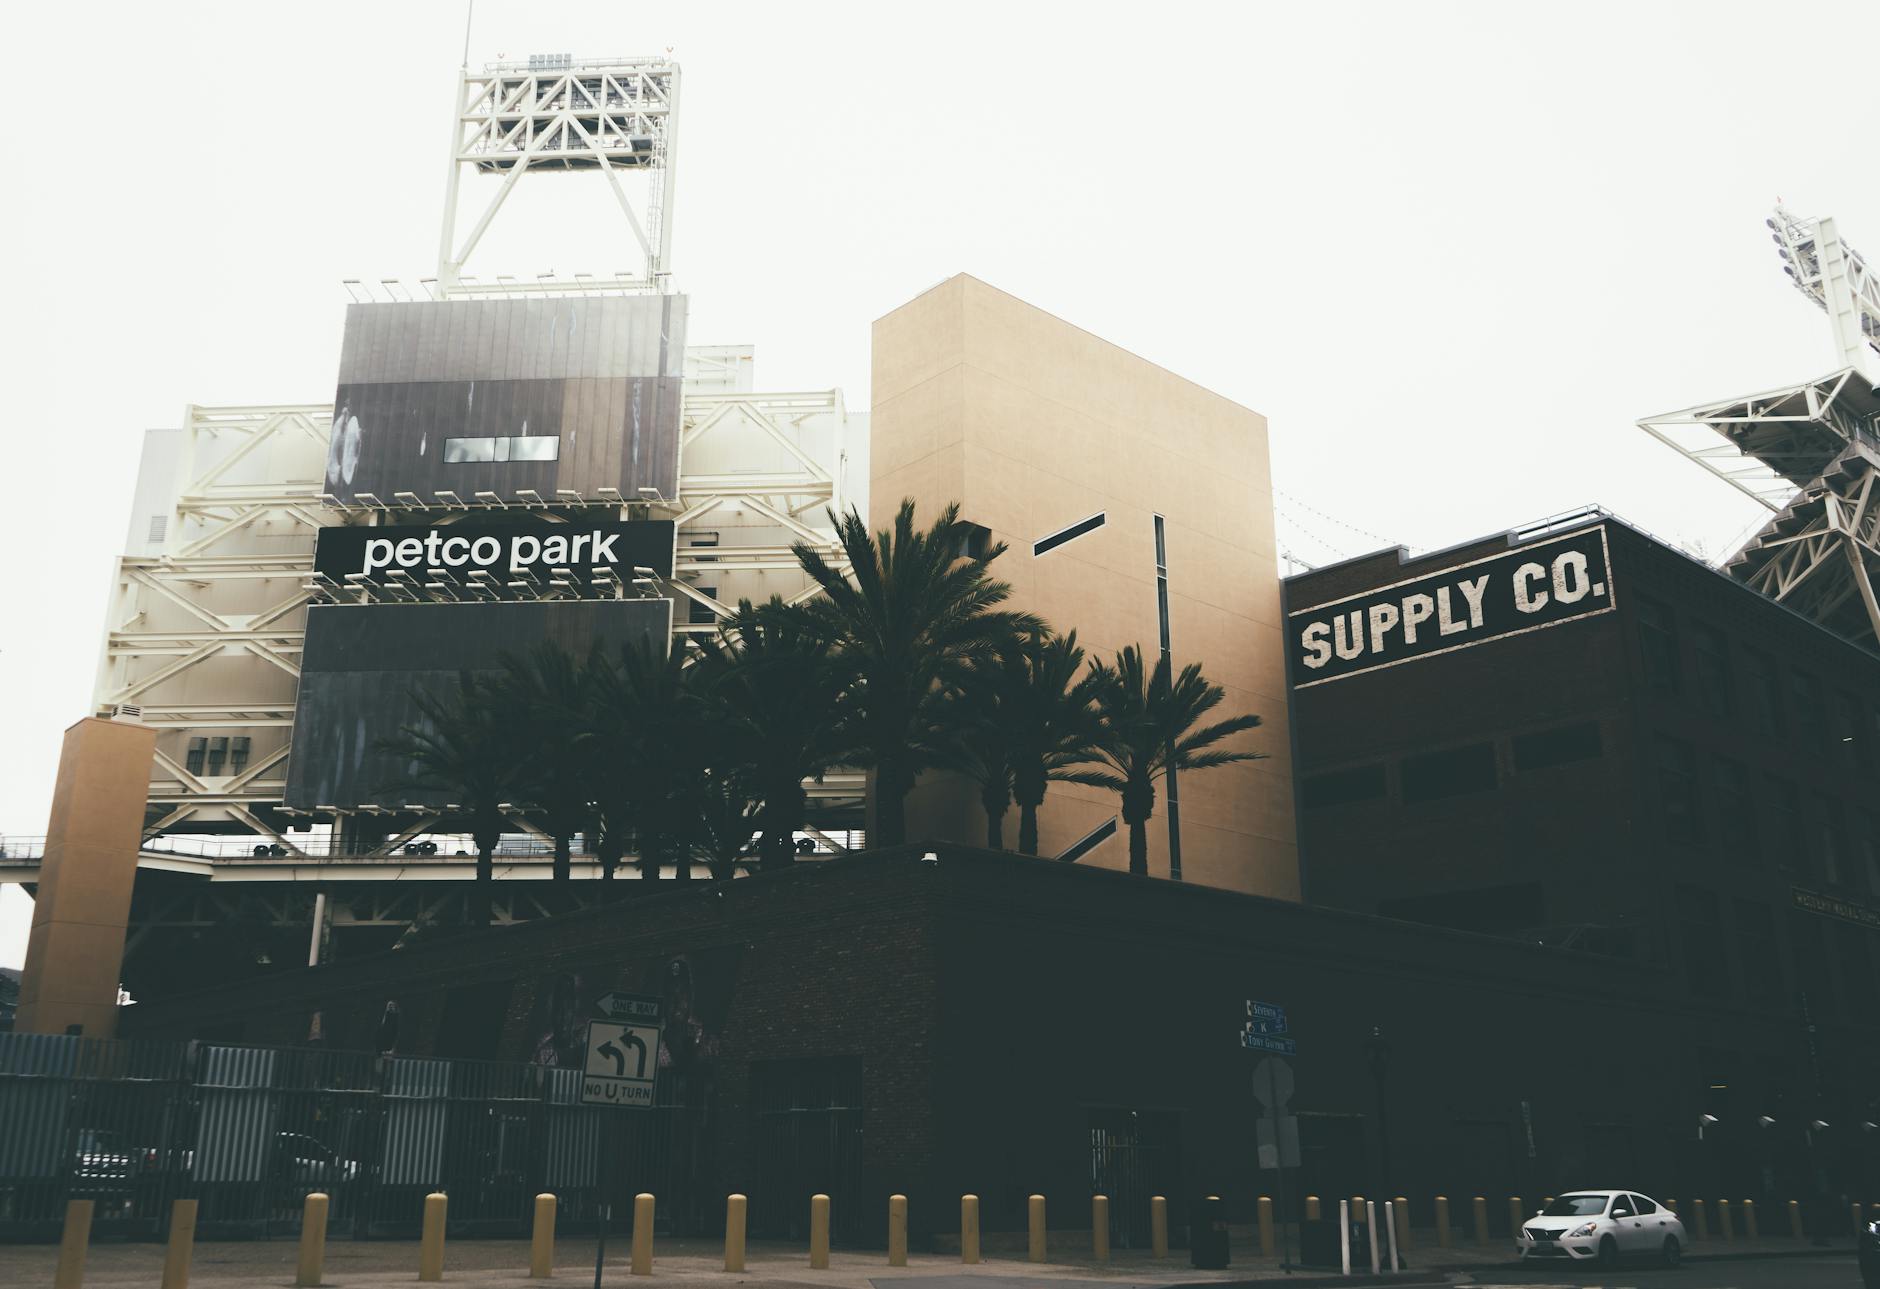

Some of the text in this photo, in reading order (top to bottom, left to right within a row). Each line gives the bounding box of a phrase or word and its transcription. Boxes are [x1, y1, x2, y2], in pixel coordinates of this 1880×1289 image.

[363, 529, 621, 576] petco park
[1301, 550, 1606, 669] SUPPLY CO.
[612, 999, 656, 1016] ONE WAY
[584, 1083, 651, 1099] NO U TURN
